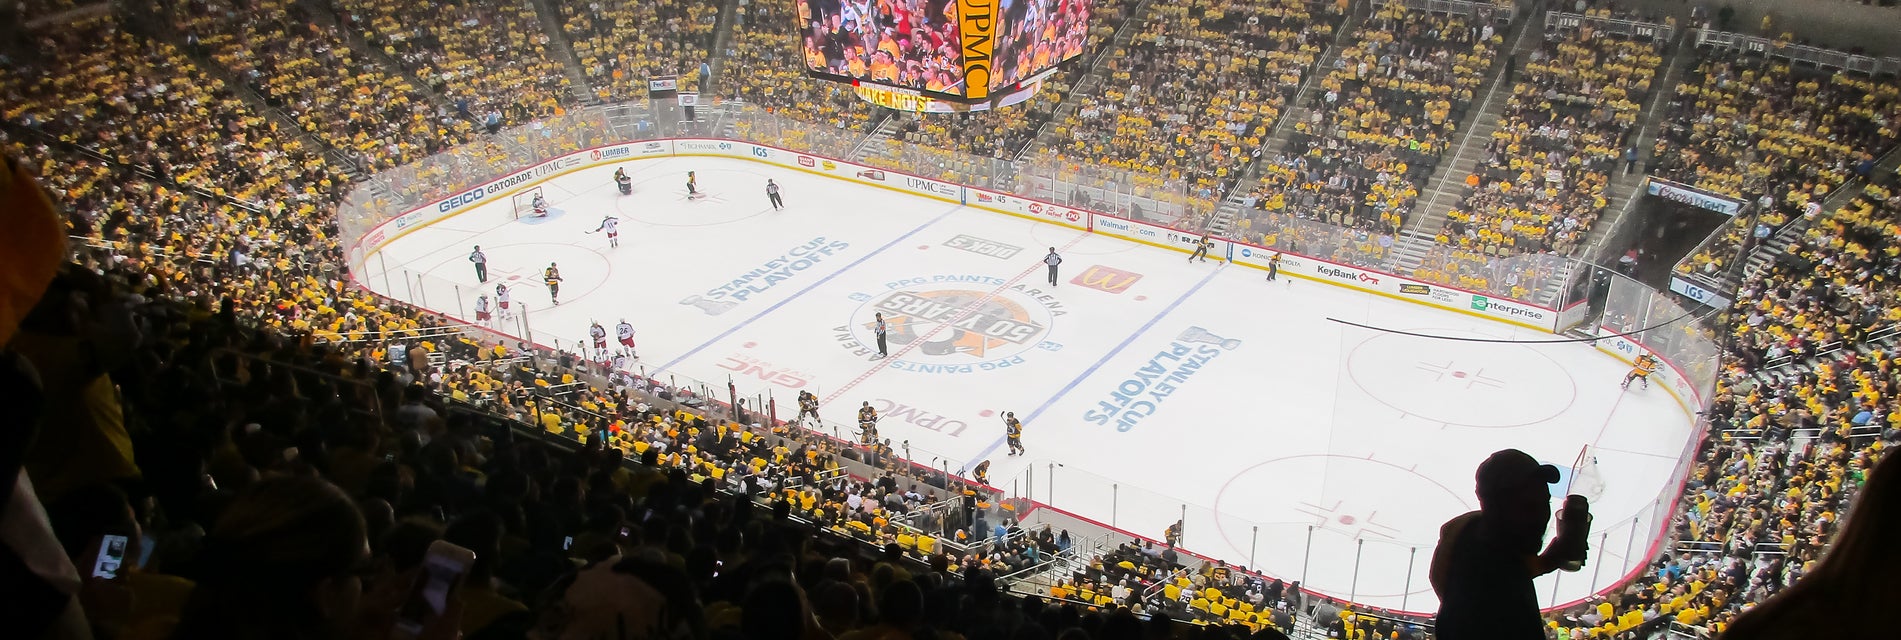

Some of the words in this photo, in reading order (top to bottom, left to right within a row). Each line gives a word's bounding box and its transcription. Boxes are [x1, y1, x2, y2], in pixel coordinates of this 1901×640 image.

[1637, 27, 1653, 36] 114
[1749, 42, 1764, 52] 115
[602, 147, 630, 158] LUMBER
[752, 146, 768, 158] IGS
[535, 159, 564, 177] UPMC
[487, 171, 532, 194] GATORADE
[906, 177, 939, 193] UPMC
[439, 188, 484, 213] GEICO
[1100, 219, 1129, 231] Walmart
[1139, 228, 1155, 237] com
[707, 255, 790, 300] STANLEY
[789, 236, 826, 257] CUP
[730, 240, 849, 302] PLAYOFFS
[1317, 265, 1357, 281] KeyBank
[885, 276, 928, 290] PPG
[933, 274, 1007, 287] PAINTS
[1011, 283, 1067, 317] ARENA
[1684, 284, 1704, 300] IGS
[1476, 299, 1543, 320] enterprise
[985, 320, 1035, 342] 50
[833, 325, 884, 362] ARENA
[716, 357, 807, 389] GNC
[889, 360, 972, 374] PAINTS
[979, 355, 1026, 371] PPG
[1148, 344, 1221, 403] STANLEY
[1083, 342, 1193, 426] PLAYOFFS
[876, 398, 968, 438] UPMC
[1115, 400, 1156, 433] CUP
